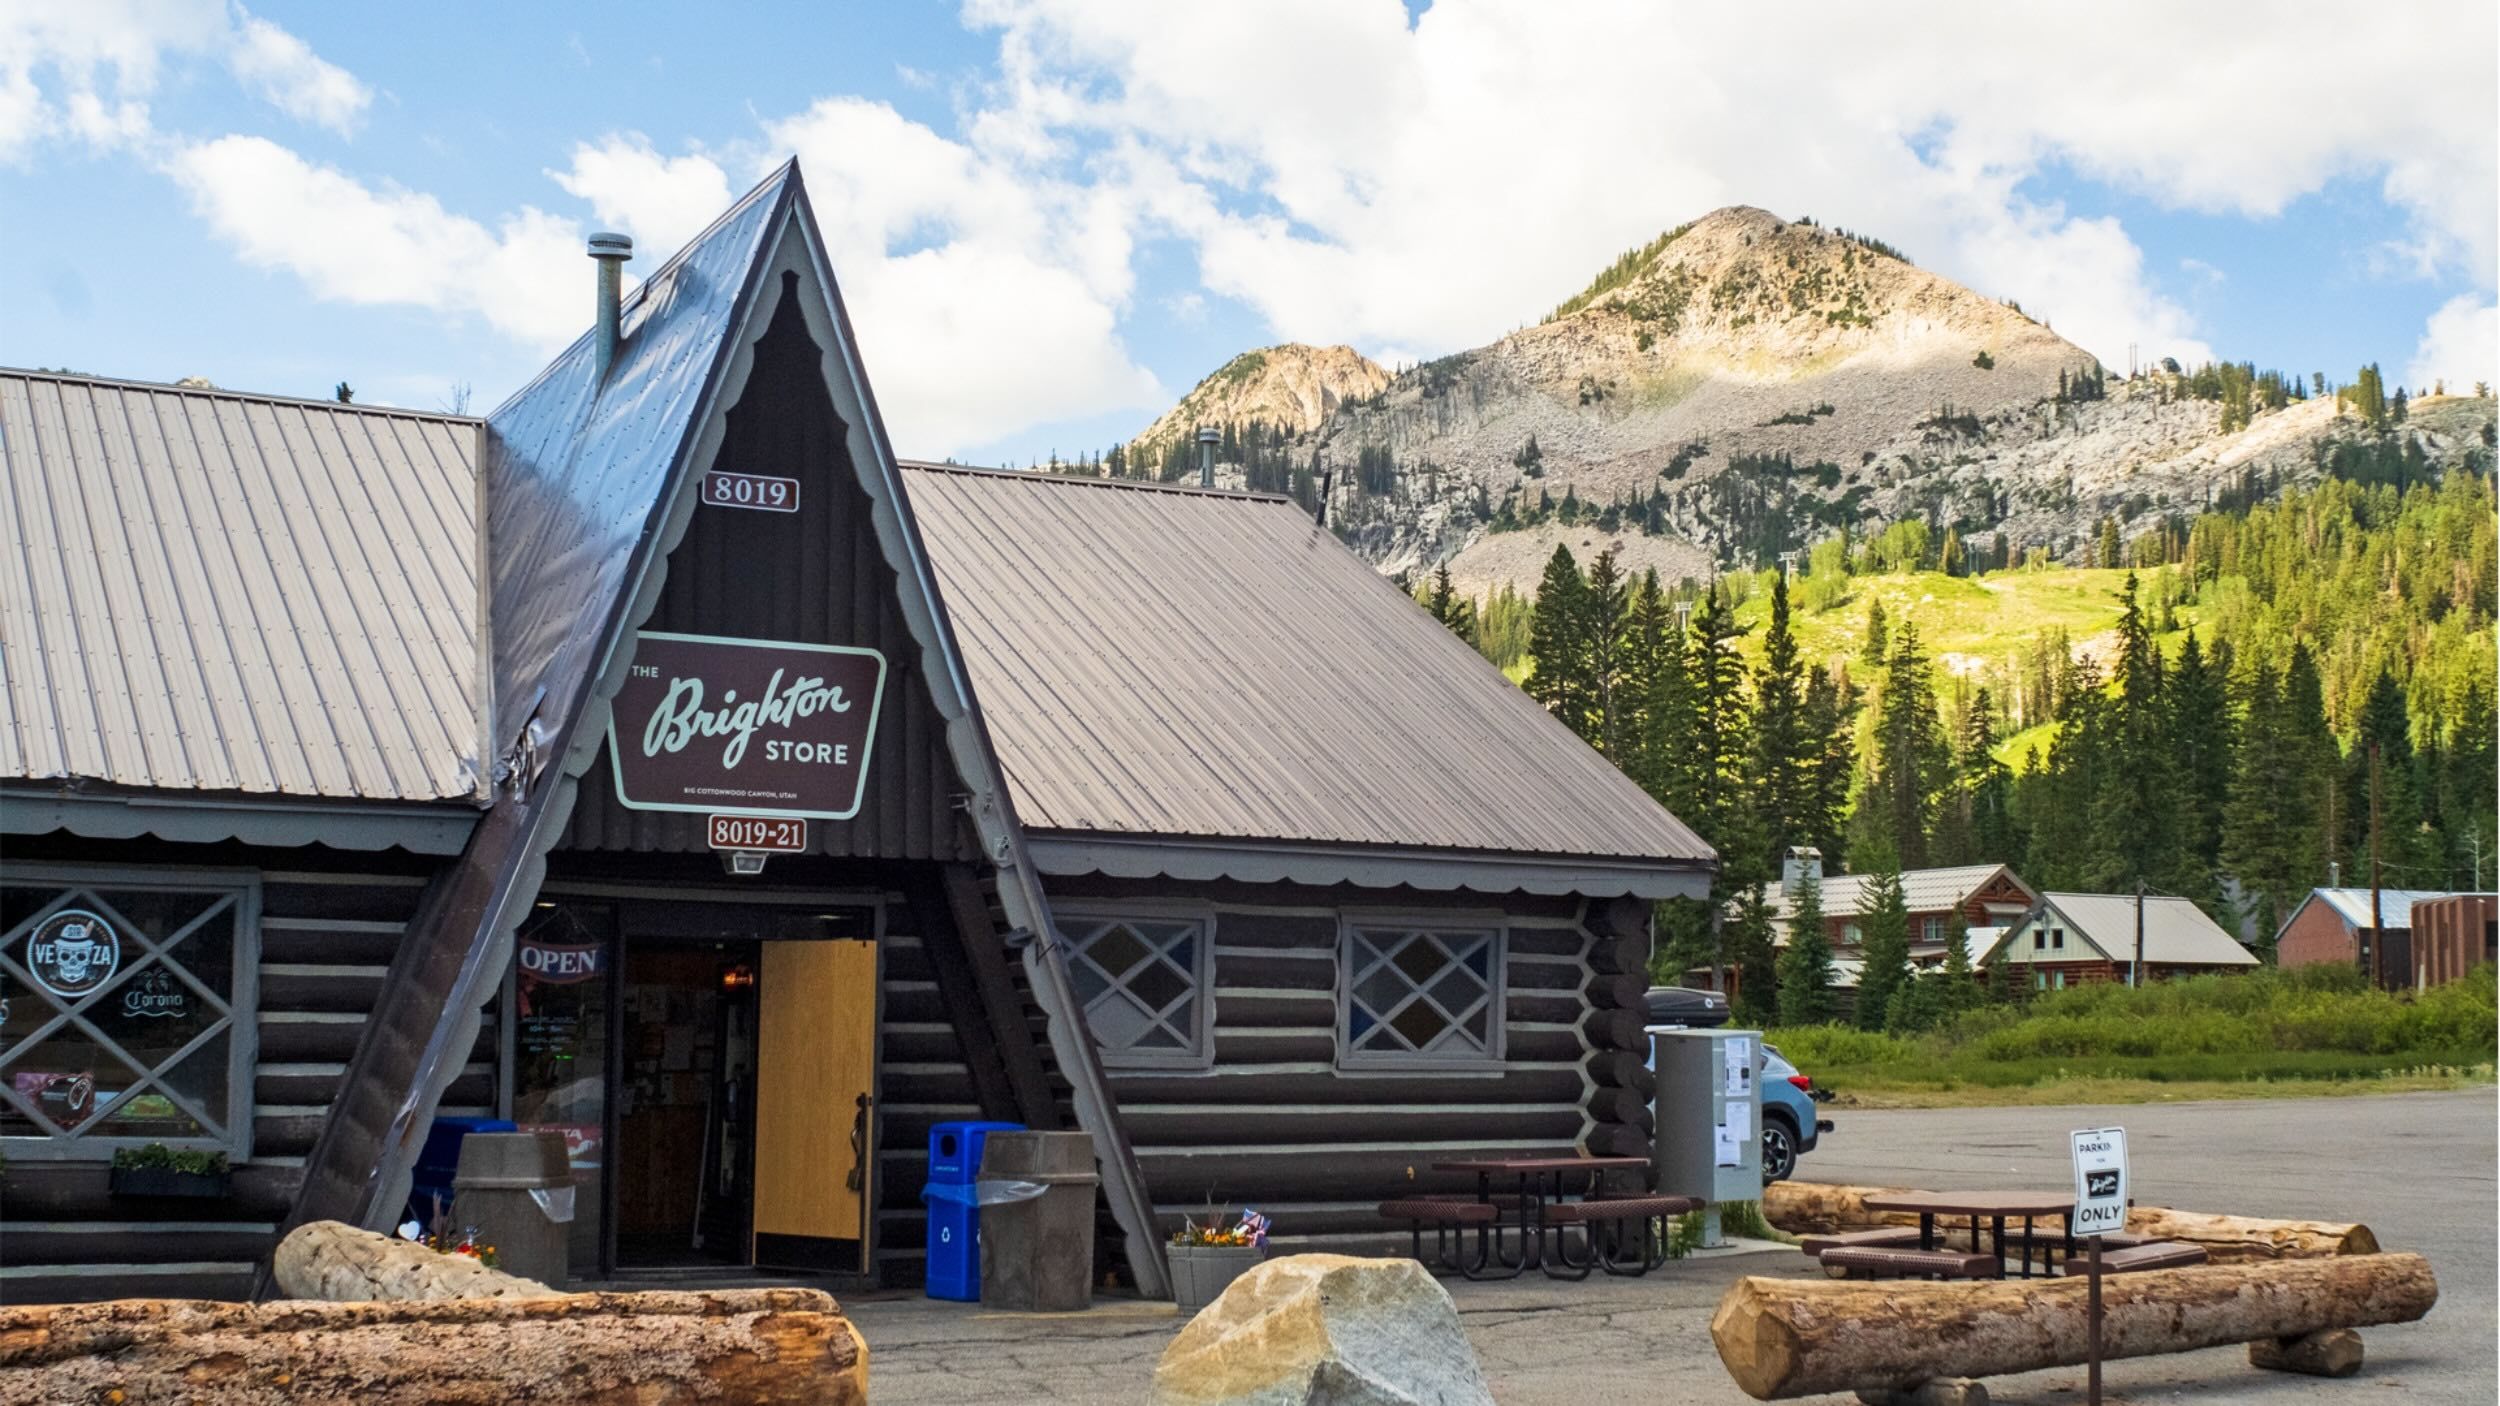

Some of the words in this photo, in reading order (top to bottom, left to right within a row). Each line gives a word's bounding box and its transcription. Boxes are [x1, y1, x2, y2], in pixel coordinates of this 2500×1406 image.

[715, 477, 787, 506] 8019
[631, 665, 659, 678] THE
[643, 668, 850, 769] Brighton
[765, 740, 848, 765] STORE
[697, 787, 747, 797] COTTONWOOD
[779, 791, 797, 799] UTAH
[715, 820, 800, 846] 8019-21
[521, 946, 597, 973] OPEN
[125, 991, 183, 1010] Corona
[2081, 1205, 2121, 1222] ONLY
